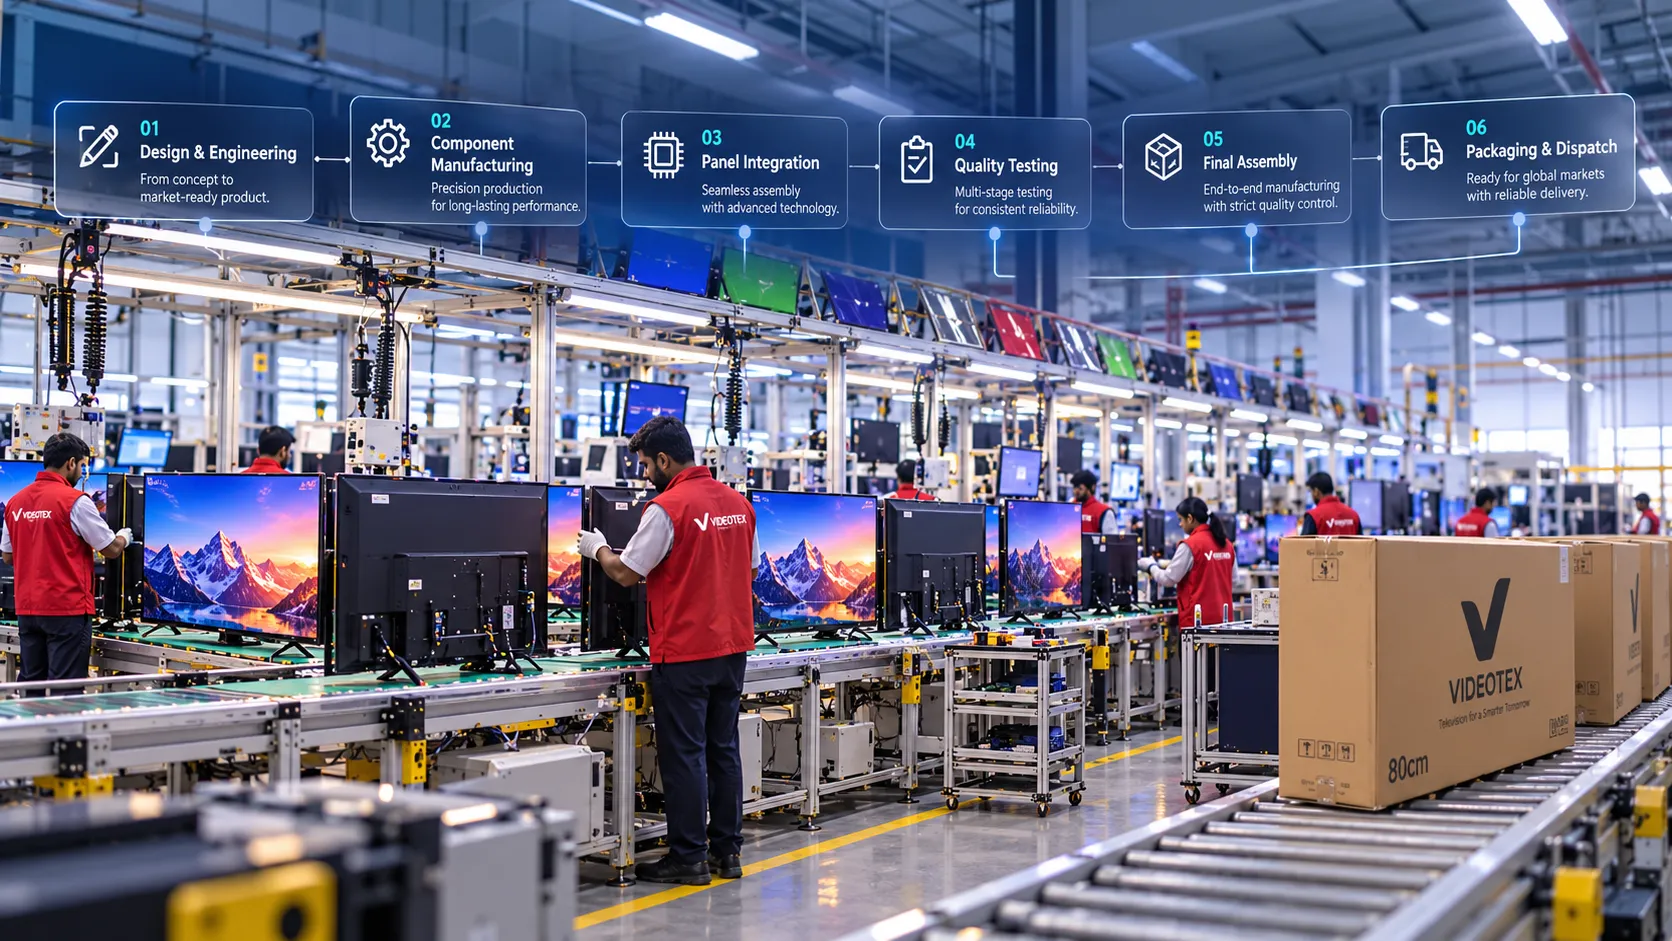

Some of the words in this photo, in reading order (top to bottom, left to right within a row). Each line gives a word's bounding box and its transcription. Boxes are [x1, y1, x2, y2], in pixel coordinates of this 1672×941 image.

[710, 514, 747, 526] VIDEOTEX
[1449, 666, 1523, 704] VIDEOTEX
[1439, 715, 1468, 729] Television
[1468, 711, 1477, 722] for
[1388, 754, 1429, 784] 80cm
